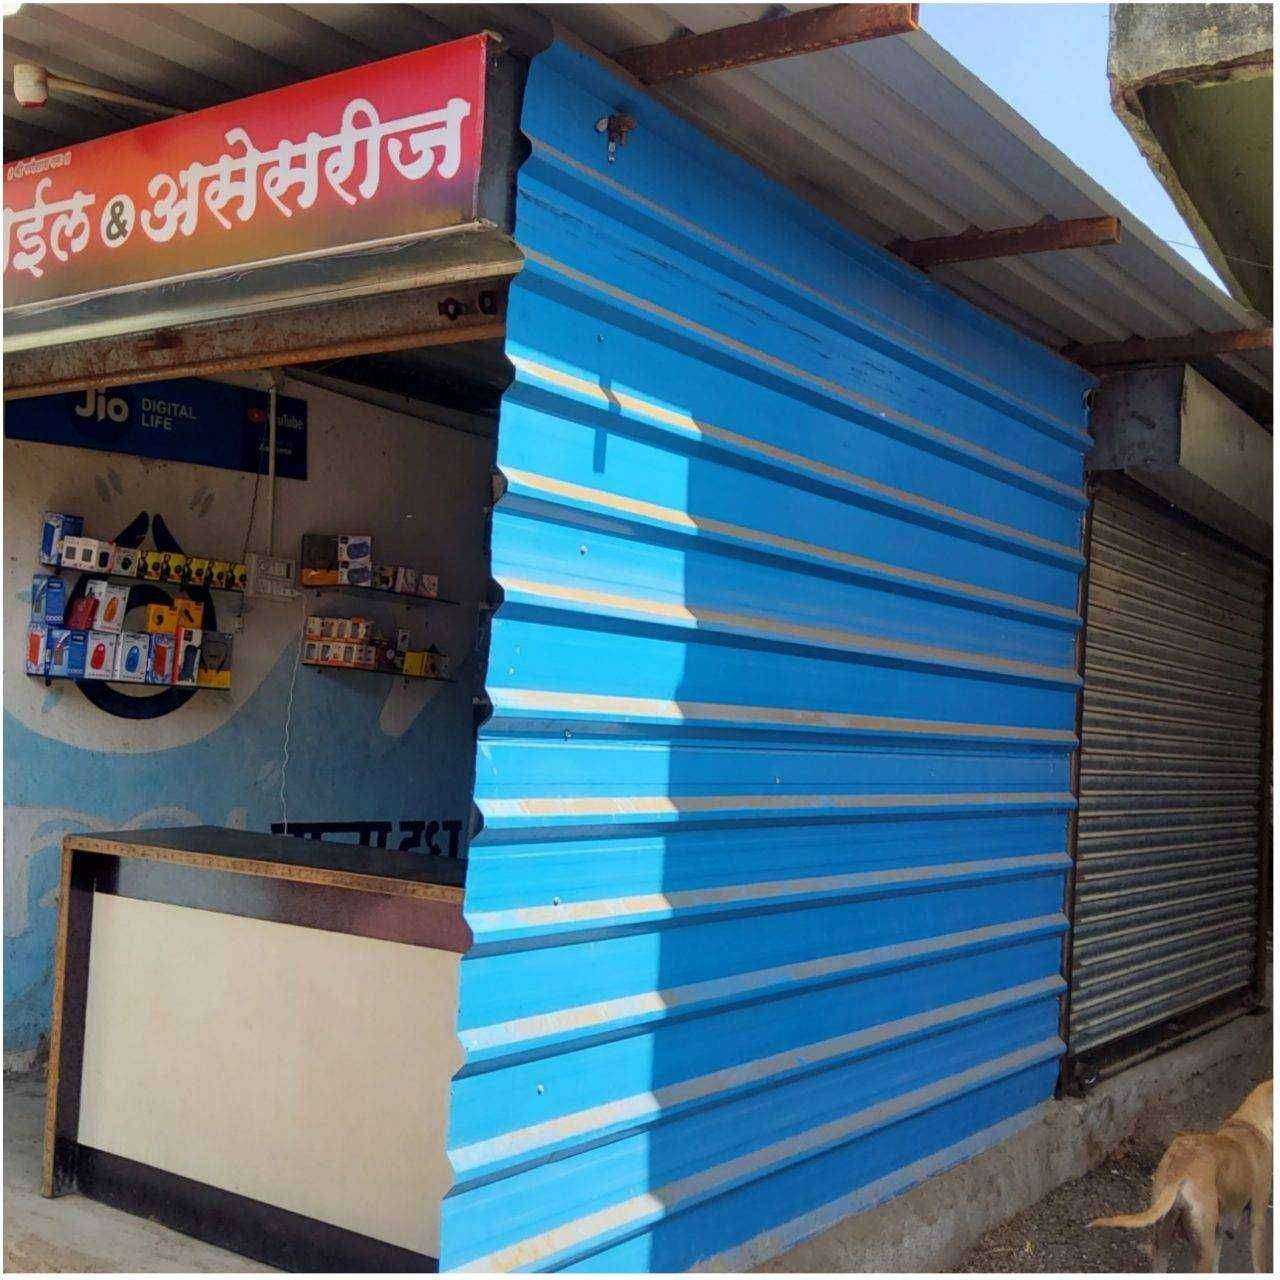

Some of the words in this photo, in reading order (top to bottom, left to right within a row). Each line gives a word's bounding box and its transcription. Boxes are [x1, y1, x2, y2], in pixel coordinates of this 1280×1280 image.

[103, 197, 131, 245] &
[140, 98, 471, 243] असेसरीज
[74, 388, 129, 424] Jio
[141, 397, 197, 421] DIGITAL
[141, 413, 173, 432] LIFE
